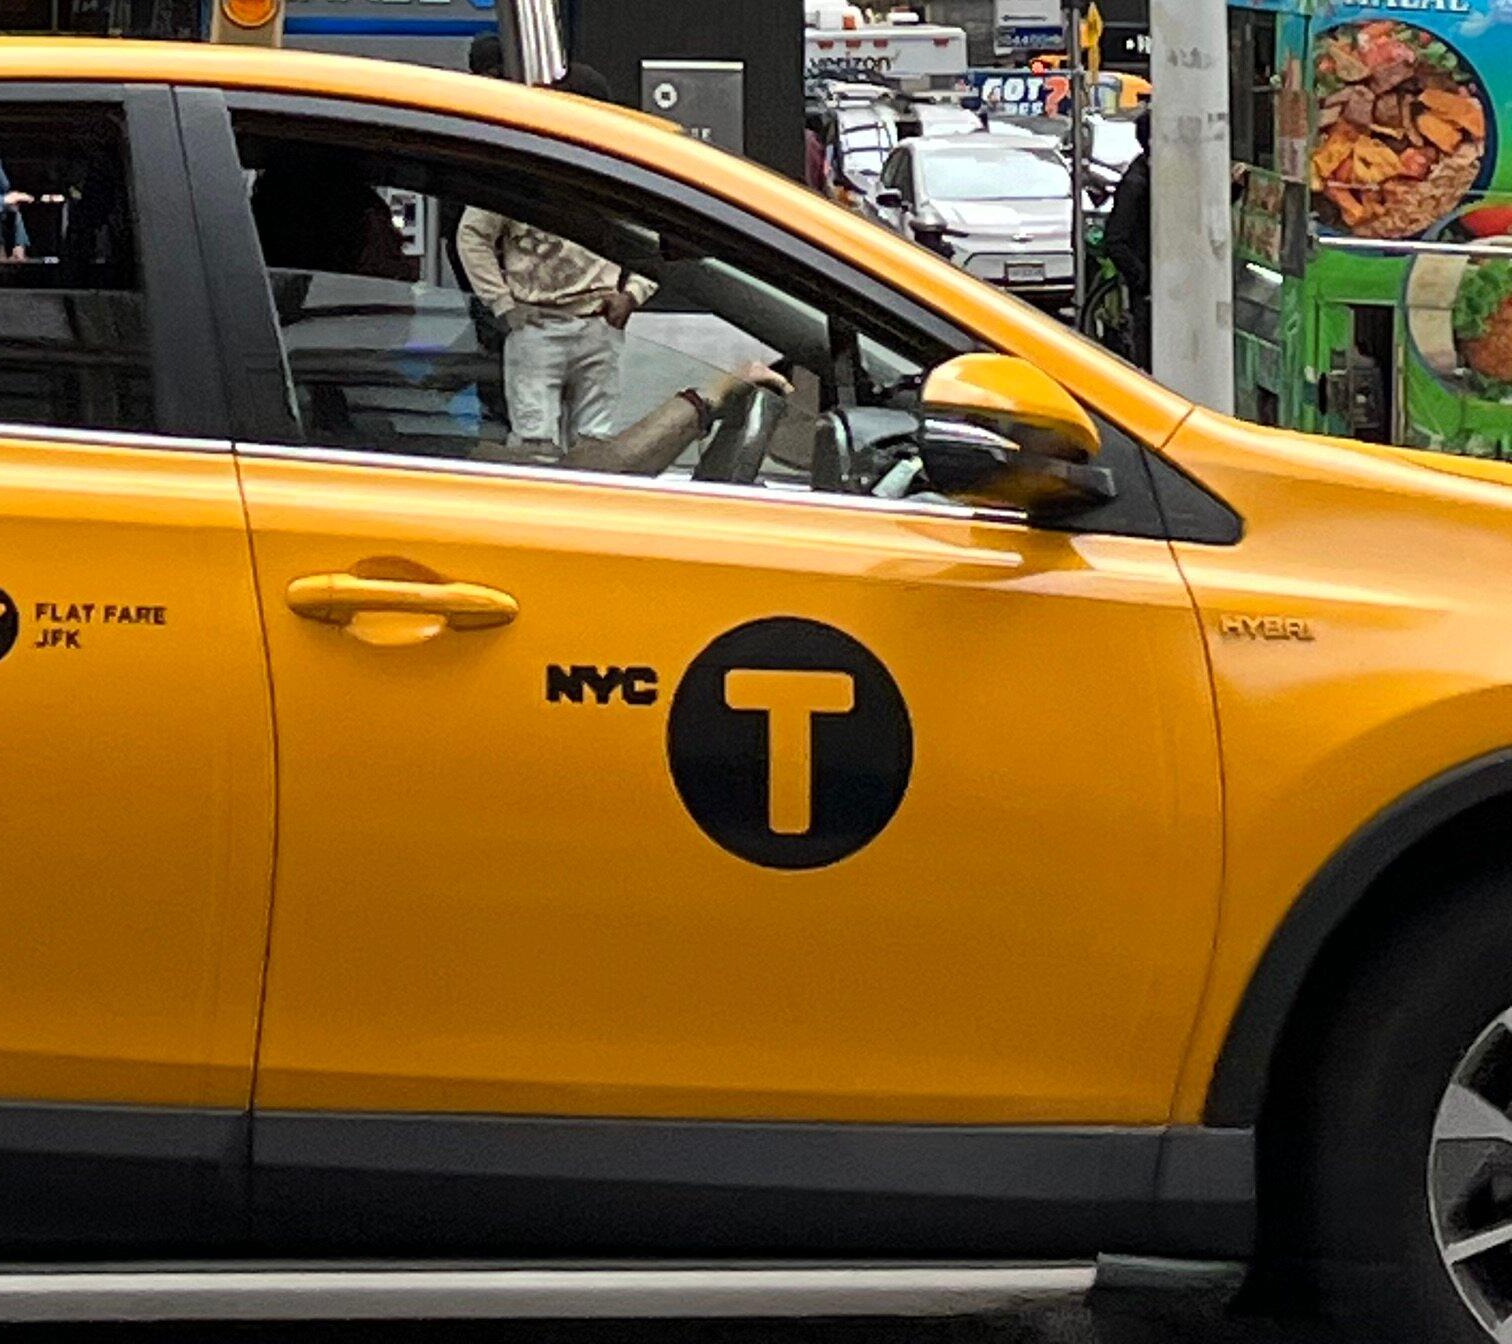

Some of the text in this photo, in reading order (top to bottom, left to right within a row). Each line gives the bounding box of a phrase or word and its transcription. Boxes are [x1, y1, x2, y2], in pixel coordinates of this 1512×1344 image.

[35, 603, 167, 625] FLAT FARE
[34, 628, 81, 649] JFK
[546, 664, 855, 835] NYC T
